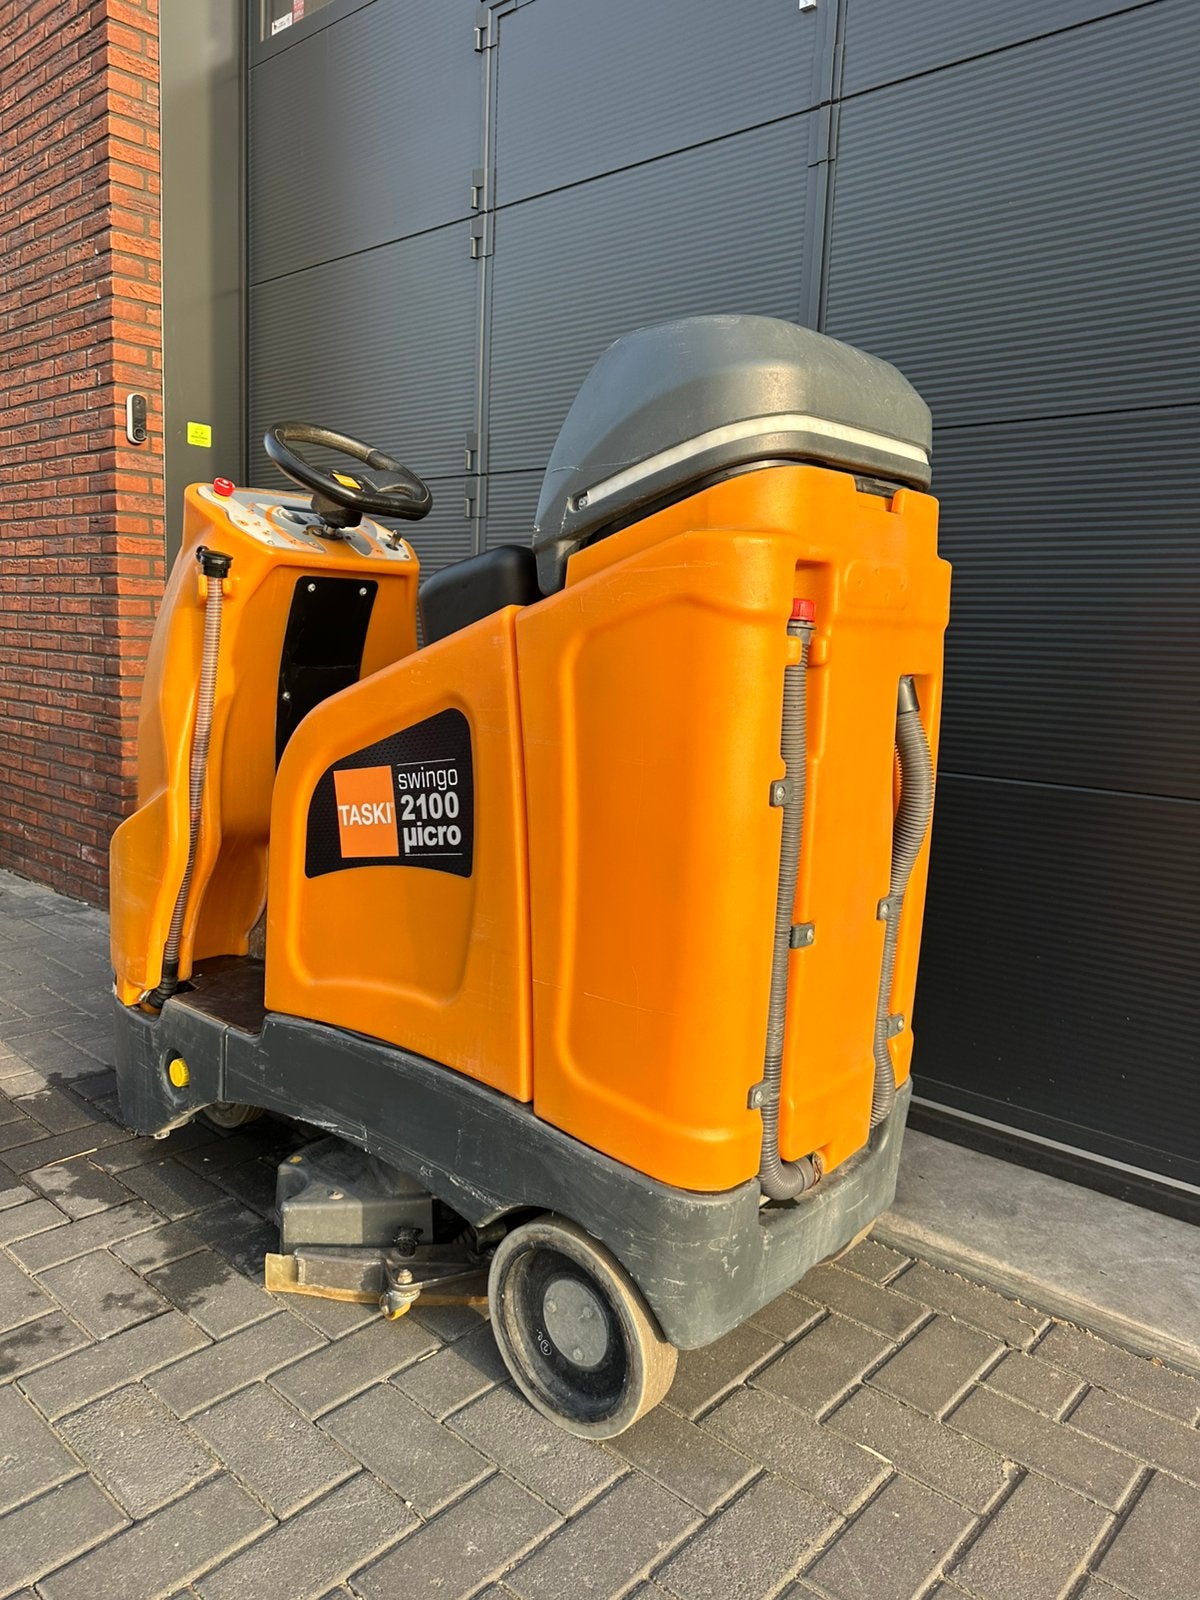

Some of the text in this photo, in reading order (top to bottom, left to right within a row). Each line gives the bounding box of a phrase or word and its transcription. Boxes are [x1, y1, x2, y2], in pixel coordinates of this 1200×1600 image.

[398, 766, 458, 791] swingo
[338, 802, 392, 826] TASKI
[400, 791, 460, 821] 2100
